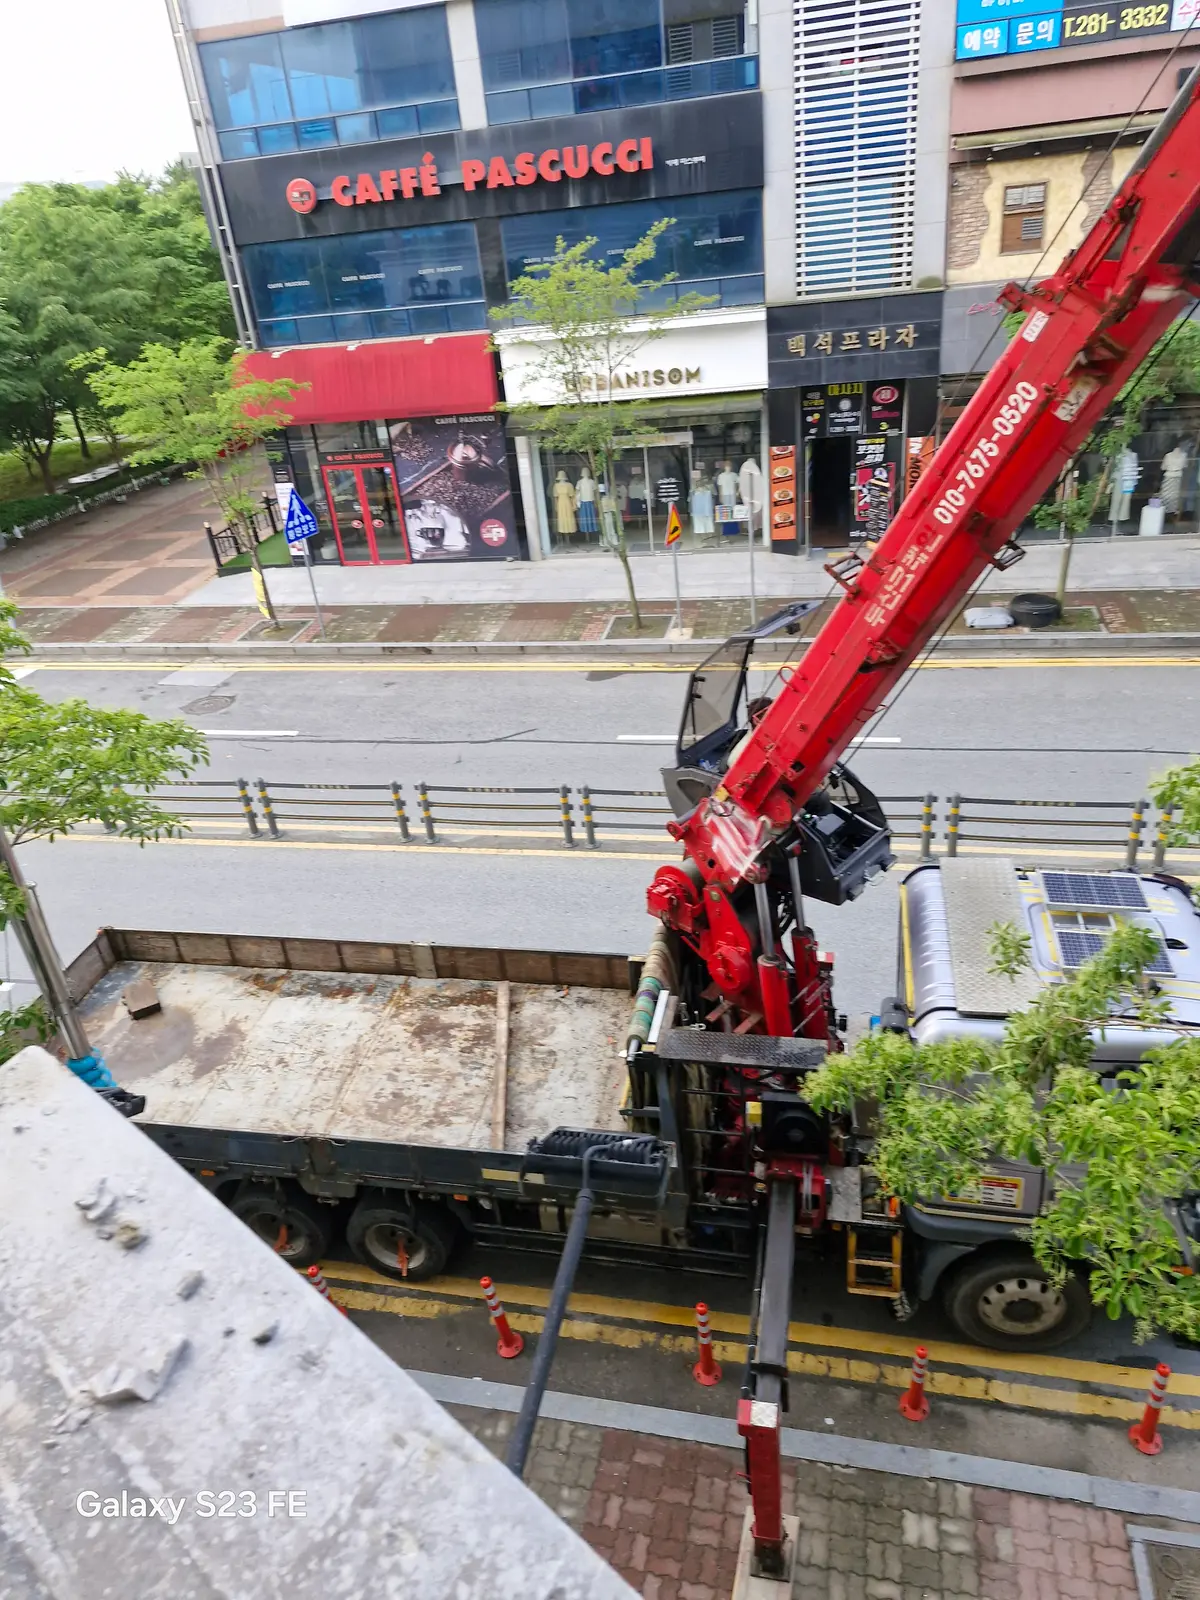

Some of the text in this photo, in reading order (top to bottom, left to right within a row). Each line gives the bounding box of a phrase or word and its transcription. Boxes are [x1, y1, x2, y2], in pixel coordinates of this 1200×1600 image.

[964, 26, 1000, 51] 예약
[1016, 19, 1054, 46] 문의
[1119, 4, 1169, 30] 3332
[331, 136, 654, 207] CAFFÉ PASCUCCI
[786, 324, 920, 357] 백석프라자
[459, 415, 495, 424] PASCUCCI
[933, 381, 1039, 525] 010-7675-0520
